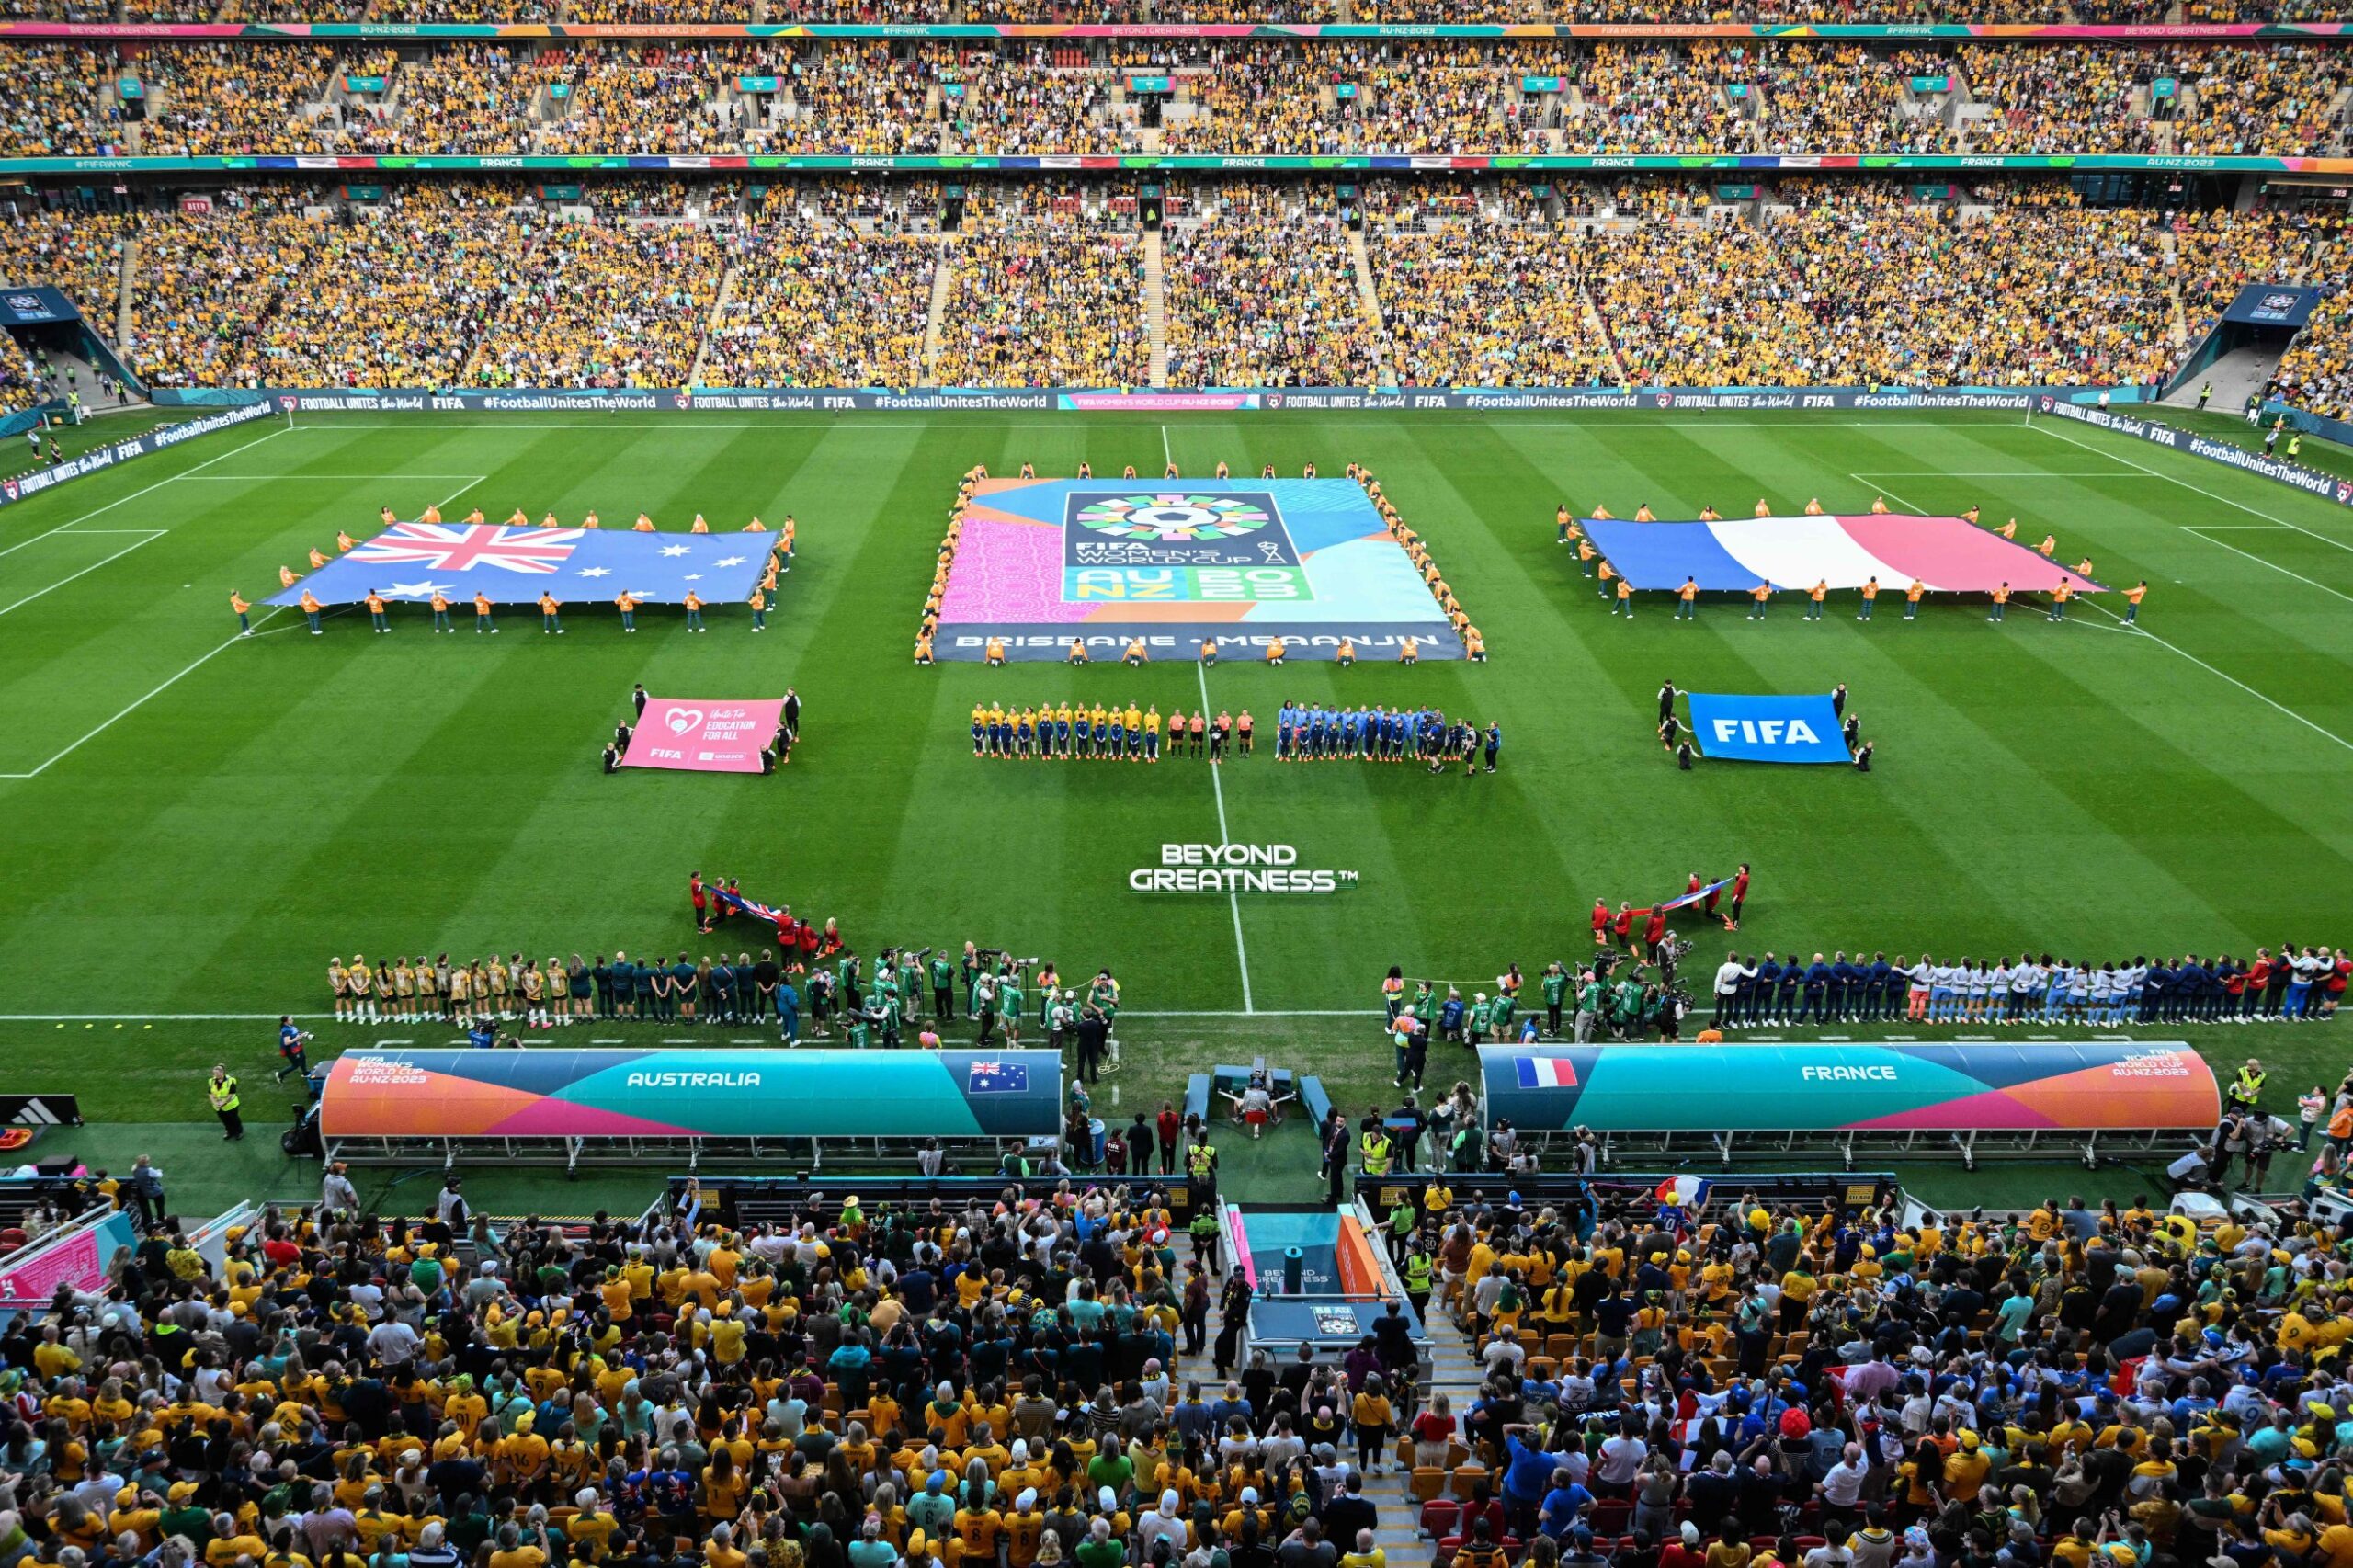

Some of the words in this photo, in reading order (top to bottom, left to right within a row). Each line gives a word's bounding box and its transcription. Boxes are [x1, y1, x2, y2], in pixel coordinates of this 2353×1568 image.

[69, 26, 113, 34] BEYOND
[595, 26, 613, 35] FIFA
[615, 26, 655, 35] WOMEN'S
[658, 26, 689, 35] WORLD
[692, 26, 709, 35] CUP
[883, 26, 929, 35] #FIFAWWC
[1112, 26, 1147, 35] BEYOND
[1601, 26, 1619, 35] FIFA
[1620, 26, 1662, 35] WOMEN'S
[1664, 26, 1695, 35] WORLD
[1697, 26, 1714, 35] CUP
[1886, 26, 1933, 35] #FIFAWWC
[2125, 26, 2165, 35] BEYOND
[480, 158, 522, 167] FRANCE
[852, 158, 893, 167] FRANCE
[1222, 158, 1265, 167] FRANCE
[1592, 158, 1634, 167] FRANCE
[1961, 158, 2004, 167] FRANCE
[188, 200, 206, 211] BEER
[301, 396, 345, 409] FOOTBALL
[347, 396, 377, 409] UNITES
[396, 396, 423, 409] World
[433, 396, 465, 409] FIFA
[483, 396, 655, 409] #FootballUnitesTheWorld
[694, 396, 738, 409] FOOTBALL
[740, 396, 768, 409] UNITES
[787, 396, 813, 409] World
[824, 396, 855, 409] FIFA
[874, 396, 1046, 409] #FootballUnitesTheWorld
[1078, 397, 1095, 407] FIFA
[1097, 398, 1131, 407] WOMEN'S
[1133, 398, 1163, 407] WORLD
[1165, 398, 1179, 407] CUP
[1286, 396, 1331, 408] FOOTBALL
[1332, 396, 1360, 408] UNITES
[1377, 396, 1404, 408] World
[1415, 396, 1446, 408] FIFA
[1465, 396, 1636, 408] #FootballUnitesTheWorld
[1675, 396, 1720, 408] FOOTBALL
[1721, 396, 1749, 408] UNITES
[1766, 396, 1794, 408] World
[1803, 396, 1834, 408] FIFA
[1854, 396, 2028, 408] #FootballUnitesTheWorld
[155, 401, 271, 447] #FootballUnitesTheWorld
[2053, 402, 2086, 421] FOOTBALL
[2086, 408, 2109, 427] UNITES
[2122, 420, 2144, 437] World
[2150, 427, 2176, 446] FIFA
[20, 470, 55, 494] FOOTBALL
[55, 462, 79, 482] UNITES
[118, 441, 143, 460] FIFA
[2189, 438, 2332, 494] #FootballUnitesTheWorld
[1076, 569, 1173, 584] AU
[1197, 569, 1293, 583] 20
[1076, 584, 1176, 597] NZ
[1199, 584, 1299, 597] 23
[955, 636, 1176, 647] BRISBANE
[1216, 635, 1439, 646] MEAANJIN
[706, 721, 756, 730] EDUCATION
[1712, 719, 1821, 744] FIFA
[702, 732, 721, 740] FOR
[722, 732, 738, 740] ALL
[650, 748, 682, 759] FIFA
[1162, 844, 1297, 866] BEYOND
[1801, 1065, 1897, 1081] FRANCE
[627, 1073, 761, 1087] AUSTRALIA
[2245, 1407, 2258, 1424] 9
[926, 1510, 934, 1524] 8
[972, 1528, 981, 1541] 8
